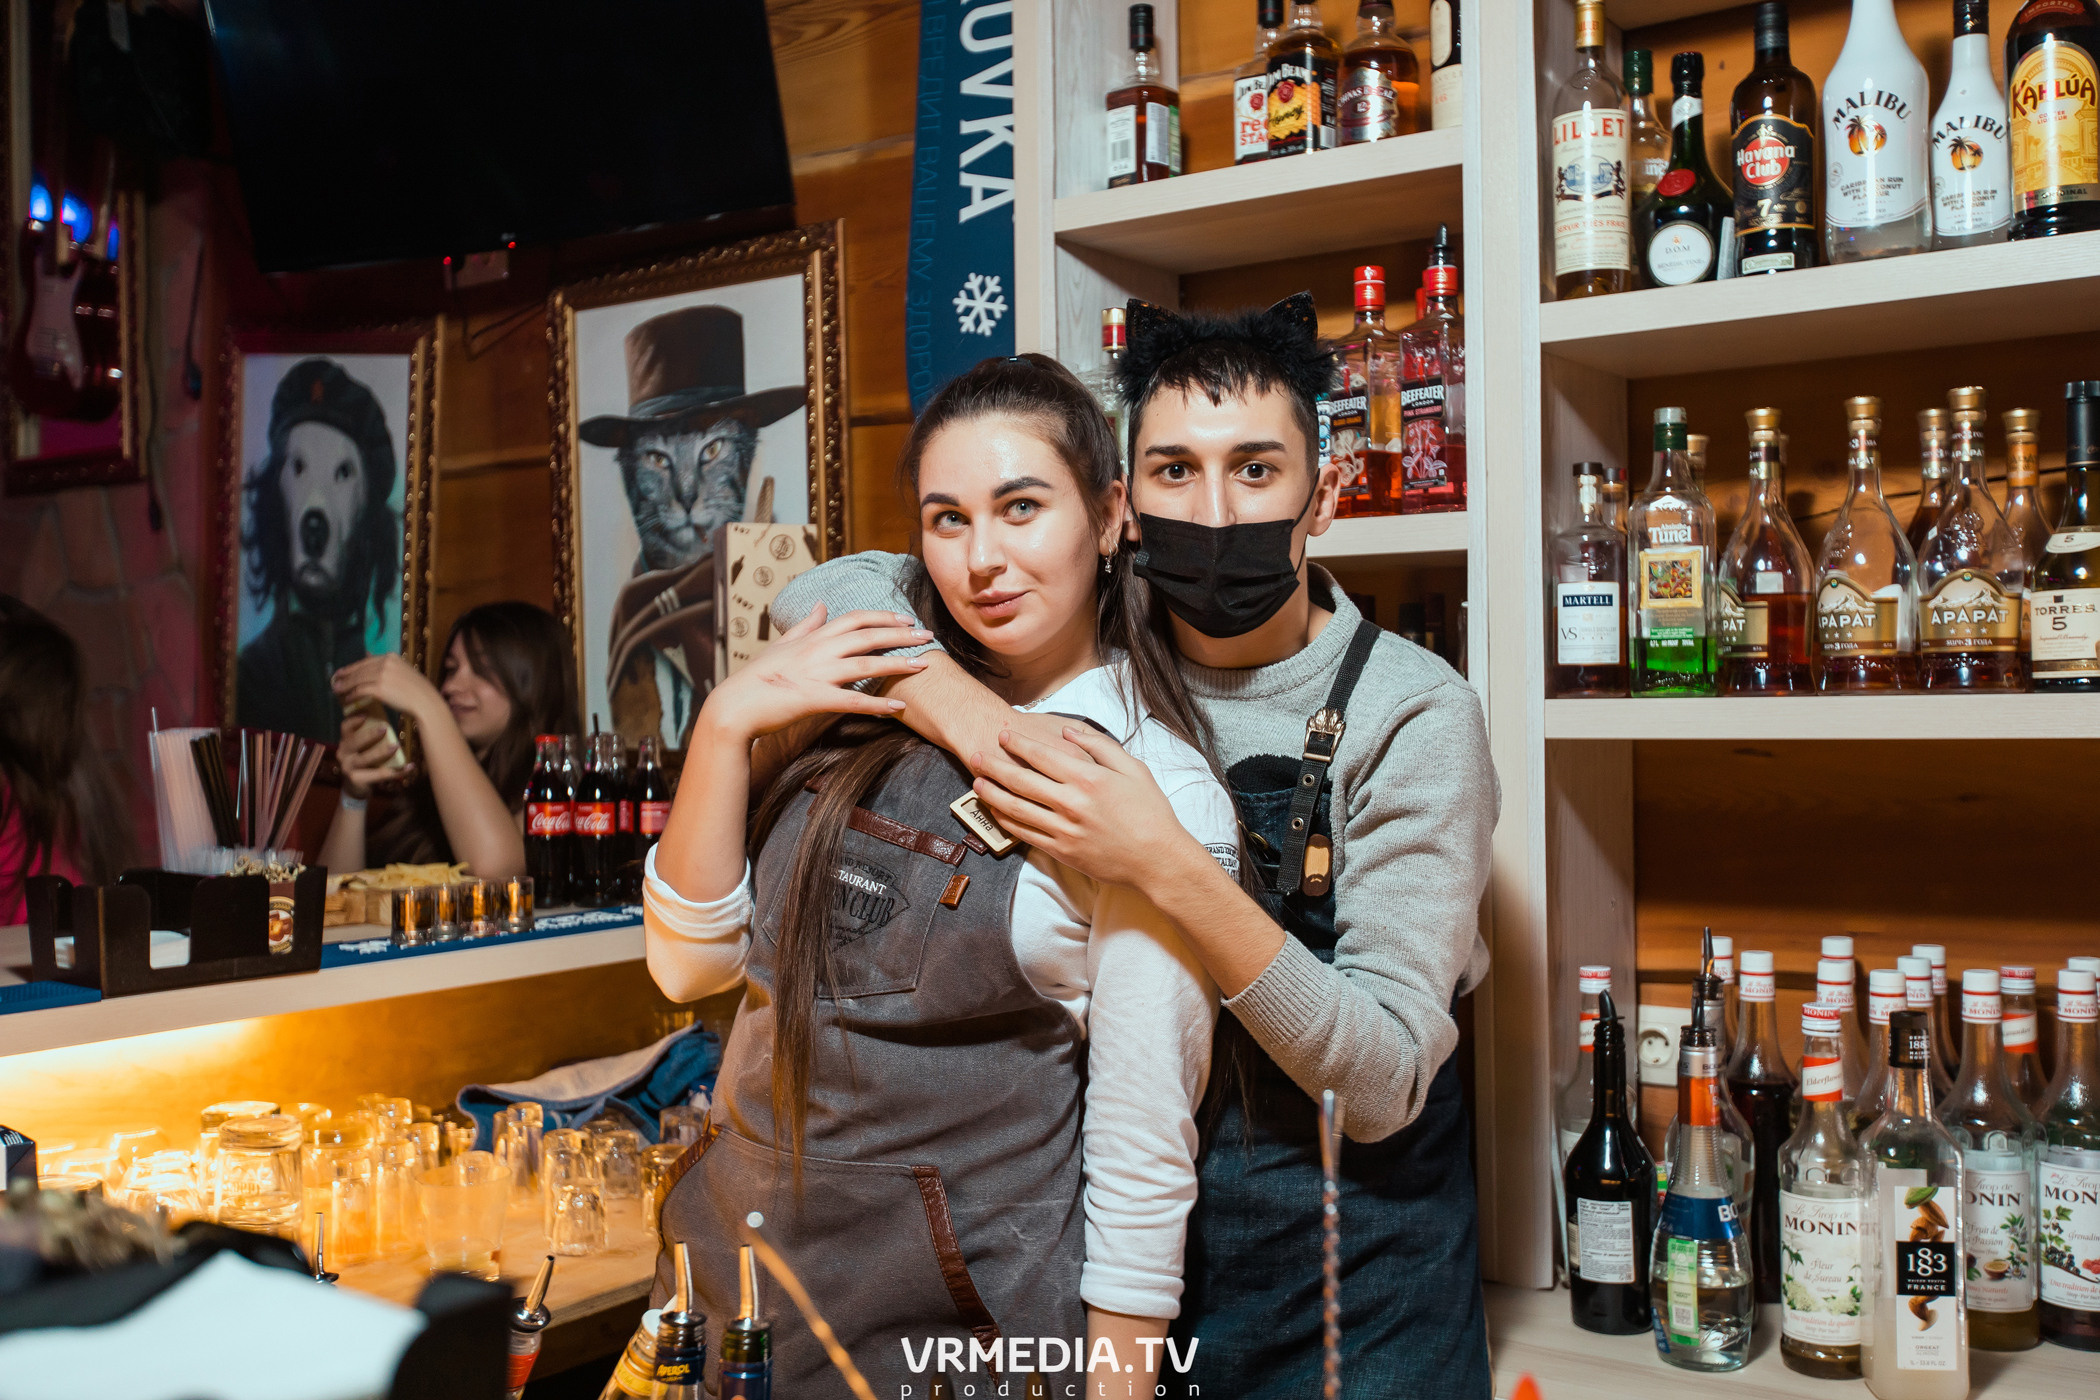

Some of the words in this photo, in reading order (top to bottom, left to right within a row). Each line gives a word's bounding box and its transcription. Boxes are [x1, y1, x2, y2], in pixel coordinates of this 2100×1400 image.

[958, 0, 1015, 225] UVKA
[1832, 89, 1912, 130] MALIBU
[1553, 117, 1626, 146] LILET
[1932, 114, 2006, 149] MALIBU
[1737, 145, 1795, 167] Havana
[1745, 160, 1782, 179] Club
[911, 145, 941, 281] ВАШЕМУ
[1757, 198, 1773, 217] 7
[1401, 384, 1445, 406] BEEFEATER
[1648, 525, 1692, 543] Tunel
[2064, 535, 2074, 543] 5
[1564, 595, 1611, 606] MARTELL
[2035, 604, 2096, 616] TORRES
[1722, 617, 1746, 631] РАТ
[1931, 605, 2008, 626] АРАРАТ
[2052, 616, 2067, 631] 5
[1561, 626, 1578, 640] VS
[970, 809, 994, 832] Анна
[838, 869, 886, 894] TAURANT
[849, 891, 895, 927] CLUB
[1803, 1008, 1834, 1017] MONIN
[1966, 1190, 2022, 1207] ONIN
[2045, 1184, 2099, 1206] MON
[1717, 1202, 1738, 1222] BO
[1808, 1204, 1838, 1221] Sirop
[1785, 1214, 1858, 1236] MONIN
[1972, 1235, 2004, 1246] Passion
[2068, 1231, 2100, 1242] Grenadin
[1811, 1258, 1835, 1271] Fleur
[1812, 1271, 1843, 1284] Sureau
[656, 1363, 691, 1377] APEROL
